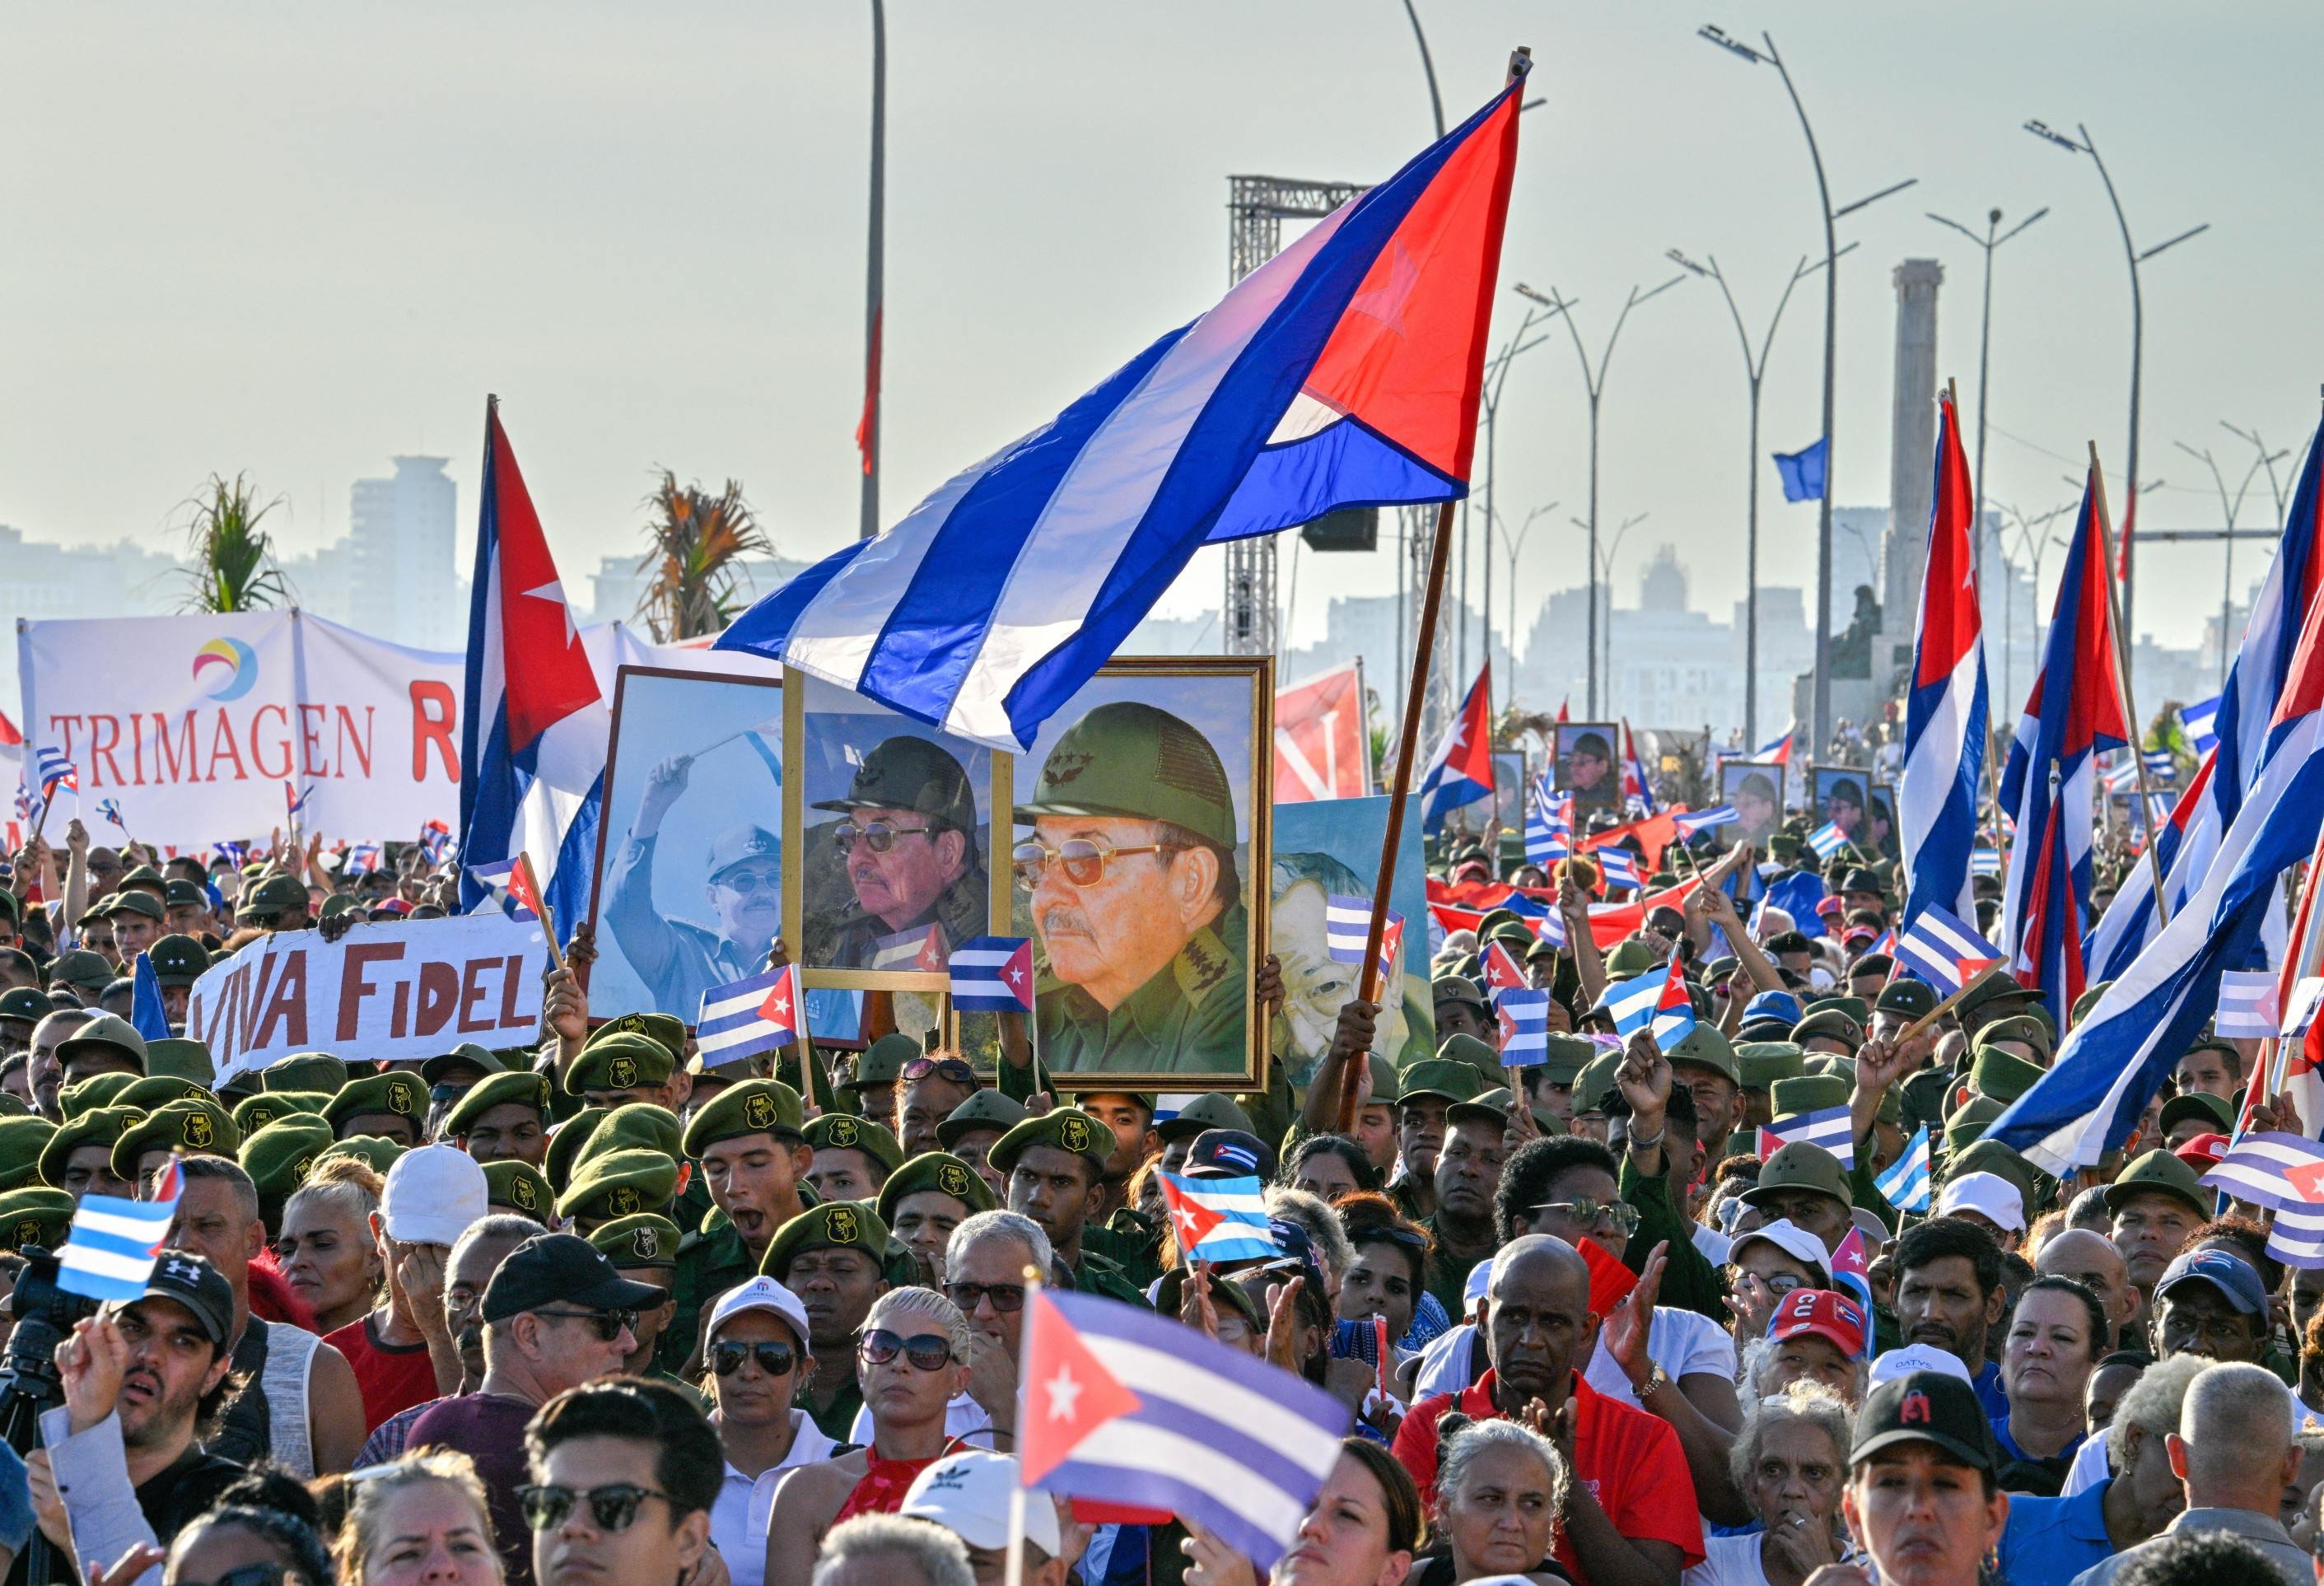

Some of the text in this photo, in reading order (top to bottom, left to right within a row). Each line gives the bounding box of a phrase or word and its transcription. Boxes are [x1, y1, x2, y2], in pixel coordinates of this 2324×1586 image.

[50, 704, 375, 787] TRIMAGEN
[193, 949, 308, 1067] VIVA
[624, 1018, 636, 1027] FAR
[190, 1090, 201, 1099] FAR
[752, 1097, 764, 1106] FAR
[193, 1116, 204, 1124] FAR
[1070, 1121, 1081, 1129] FAR
[947, 1168, 960, 1176] FAR
